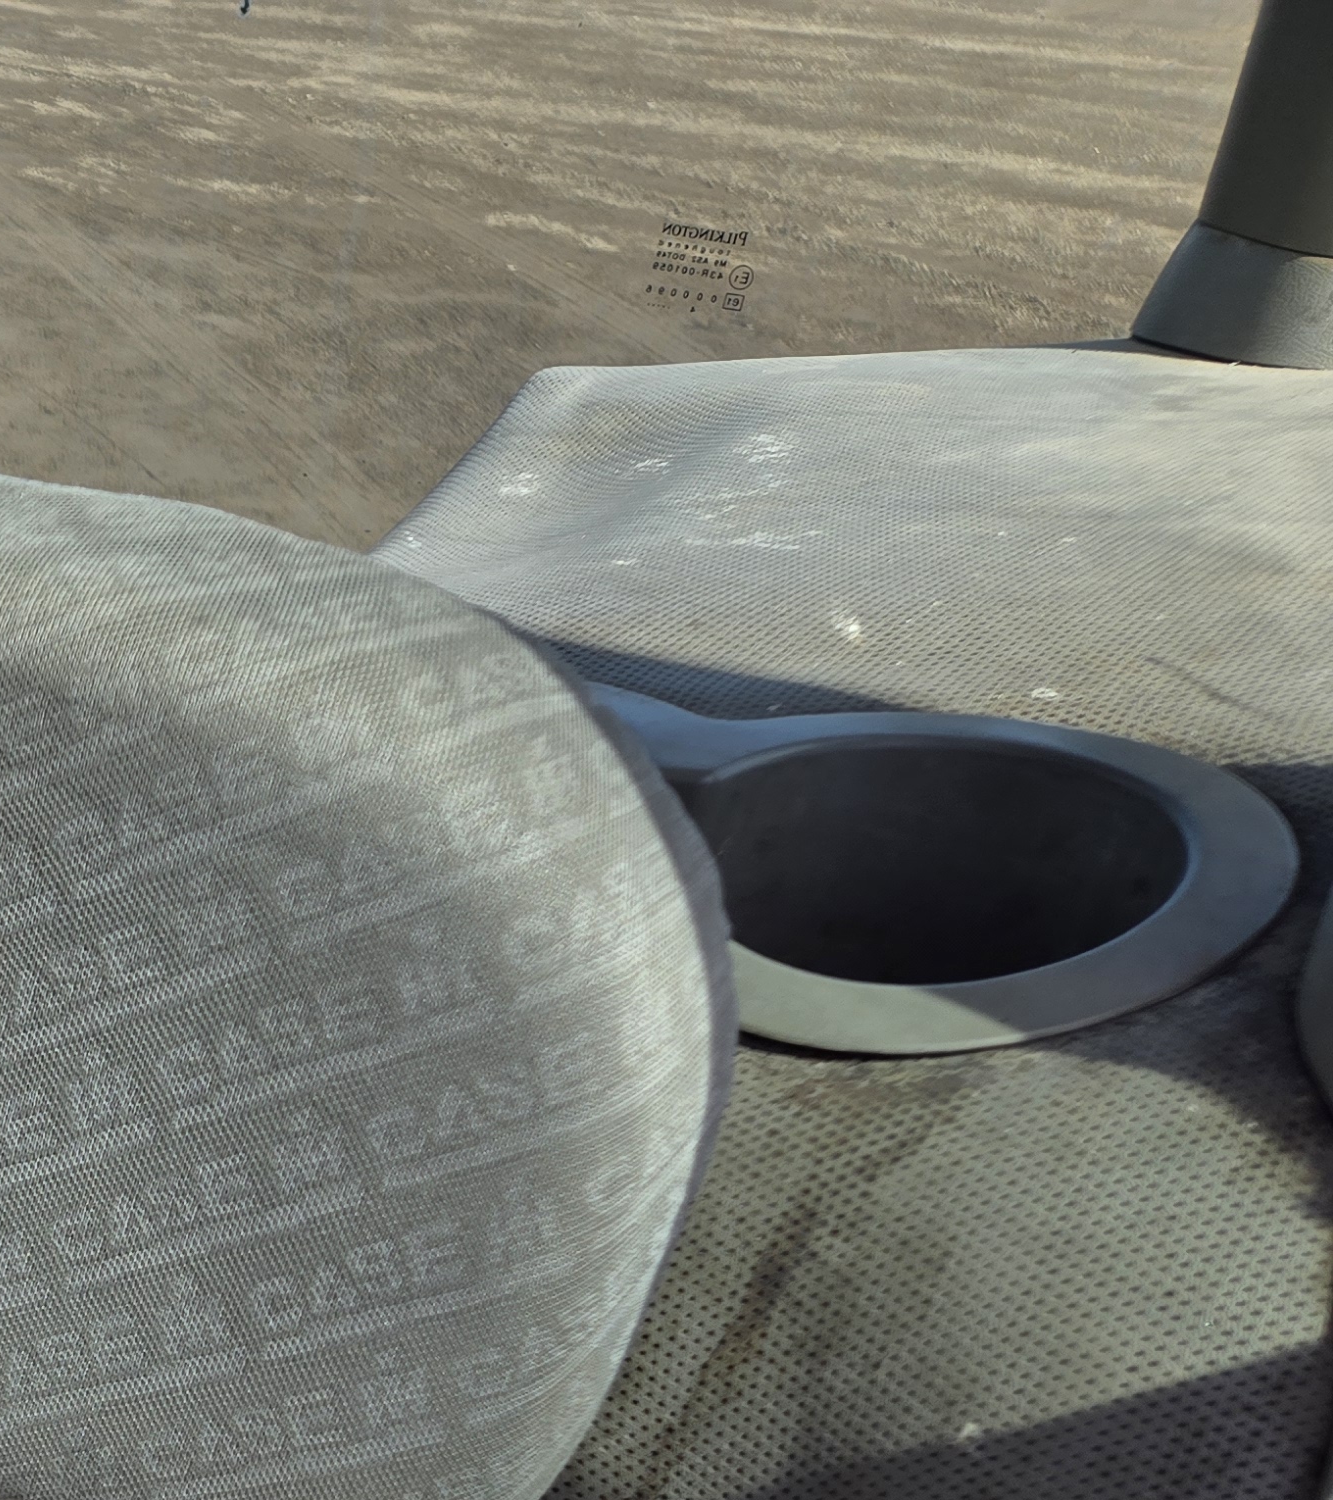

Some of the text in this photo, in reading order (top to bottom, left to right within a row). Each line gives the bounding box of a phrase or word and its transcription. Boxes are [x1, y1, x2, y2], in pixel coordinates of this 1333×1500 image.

[157, 977, 383, 1097] CASE
[50, 1155, 257, 1260] CASE
[365, 1032, 597, 1156] CASE
[247, 1216, 469, 1330] CASE
[137, 1388, 341, 1476] CASE
